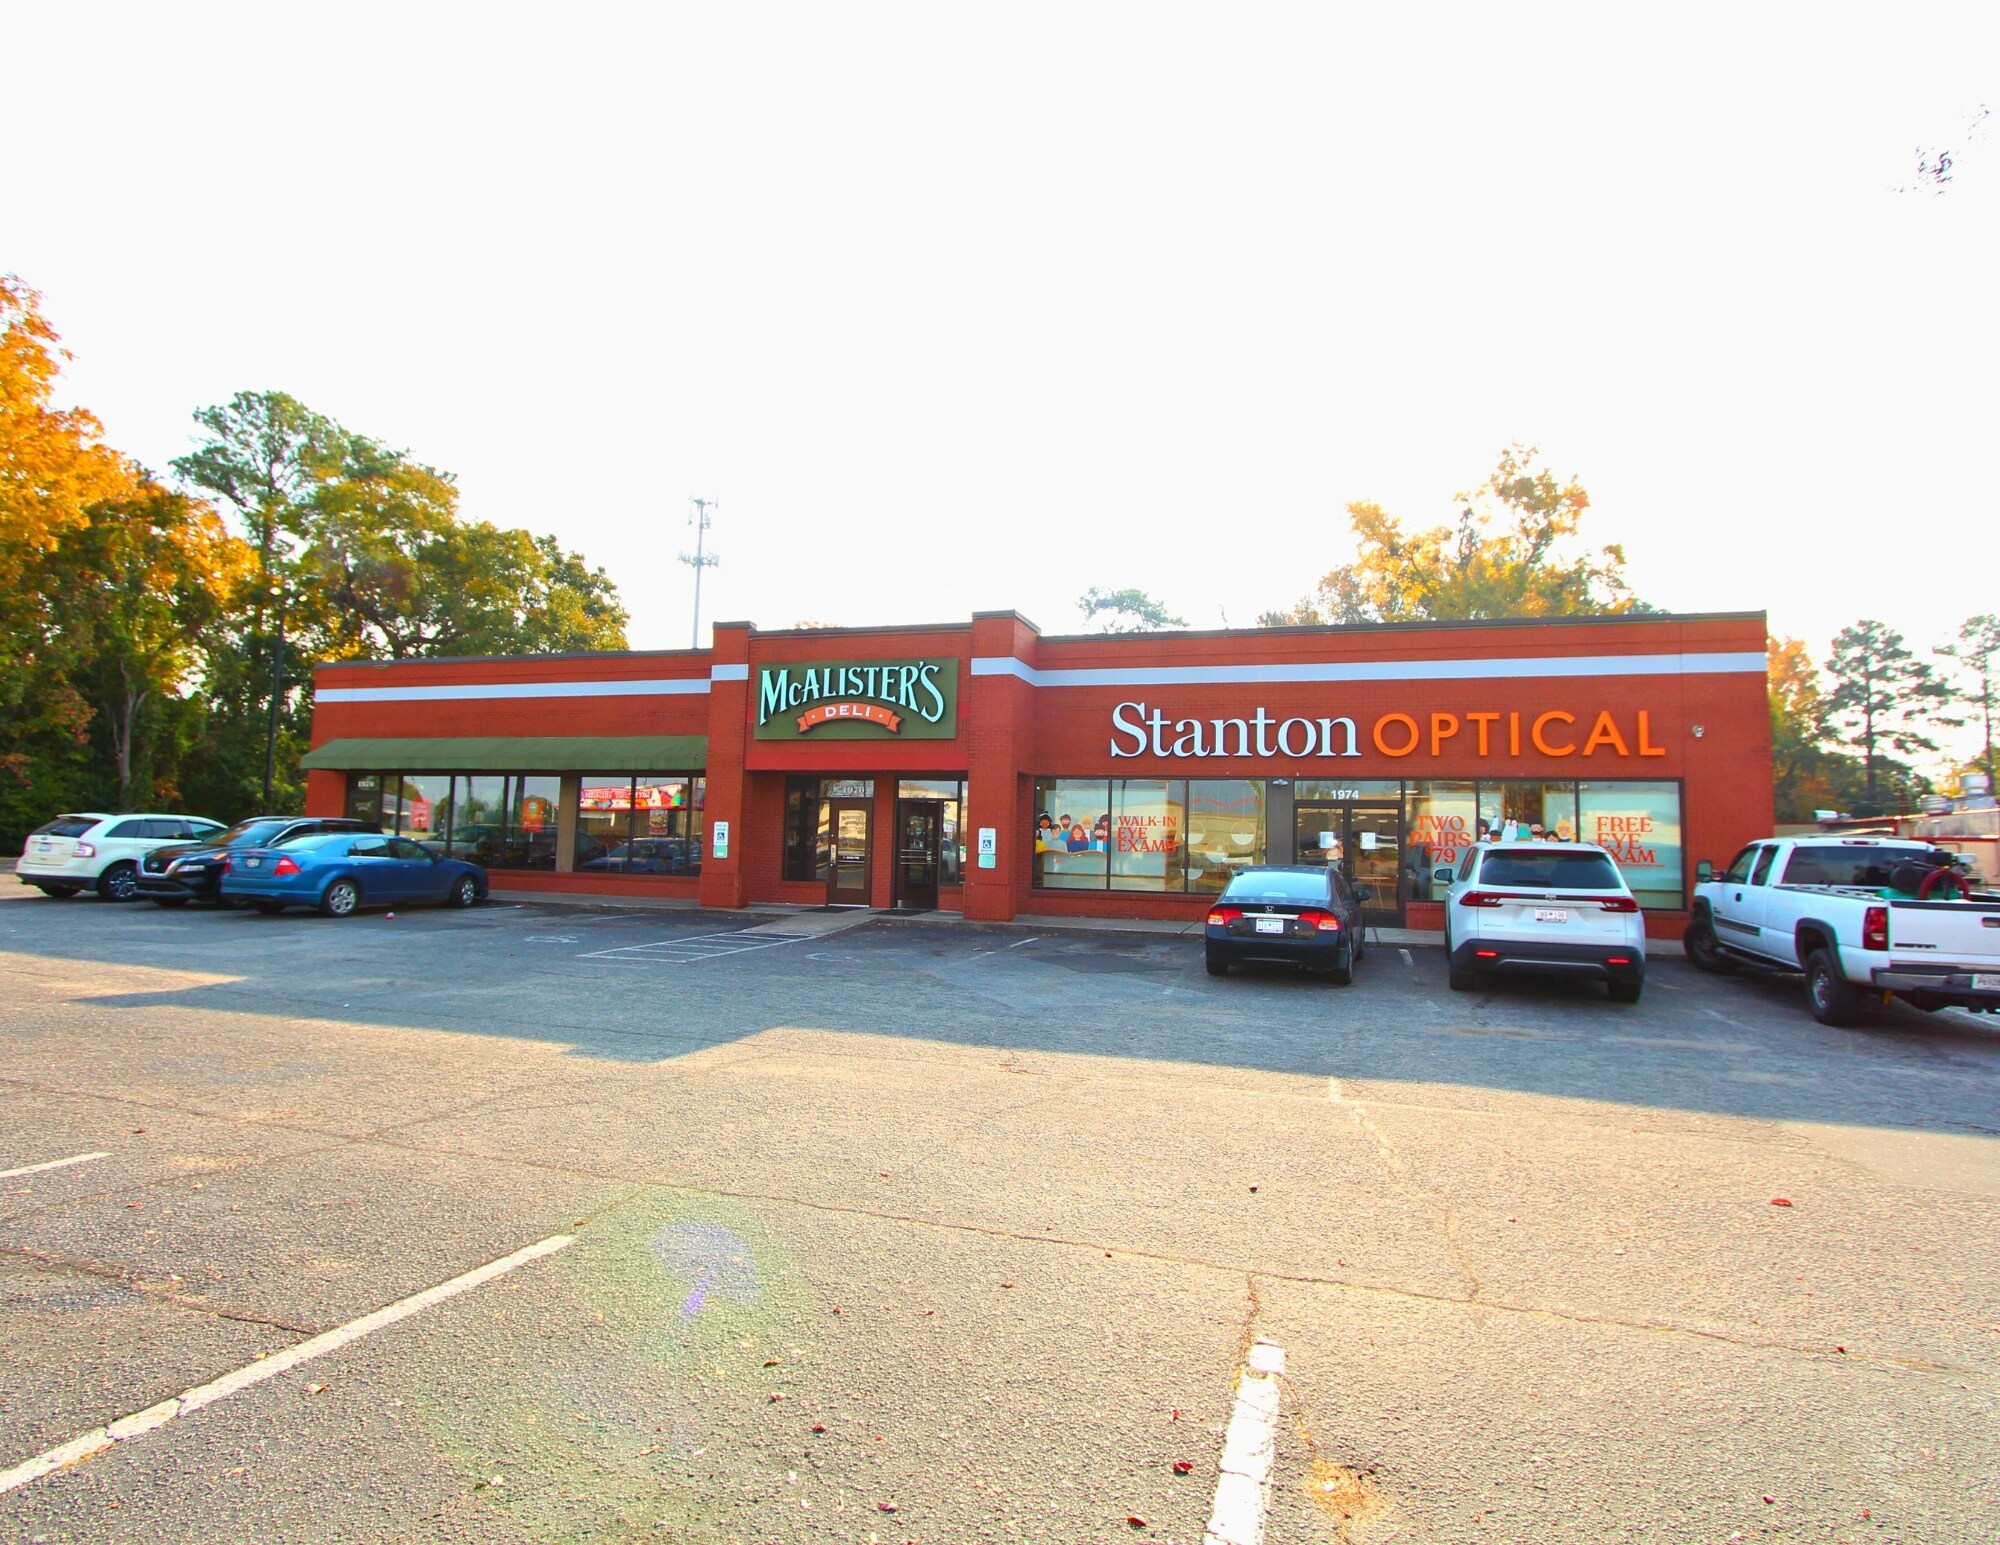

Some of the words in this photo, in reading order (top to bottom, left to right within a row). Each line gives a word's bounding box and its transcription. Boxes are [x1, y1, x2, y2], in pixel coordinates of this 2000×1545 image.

[824, 704, 871, 718] DELI
[1110, 702, 1362, 757] Stanton
[1373, 710, 1666, 757] OPTICAL
[842, 786, 865, 795] 1970
[1331, 789, 1360, 800] 1974
[1117, 815, 1177, 826] WALK-IN
[1415, 815, 1465, 831] TWO
[1597, 816, 1654, 832] FREE
[1117, 827, 1148, 839] EYE
[1408, 831, 1472, 847] PAIRS
[1597, 832, 1642, 849] EYE
[1117, 839, 1179, 853] EXAMS
[1605, 847, 1656, 863] XAM
